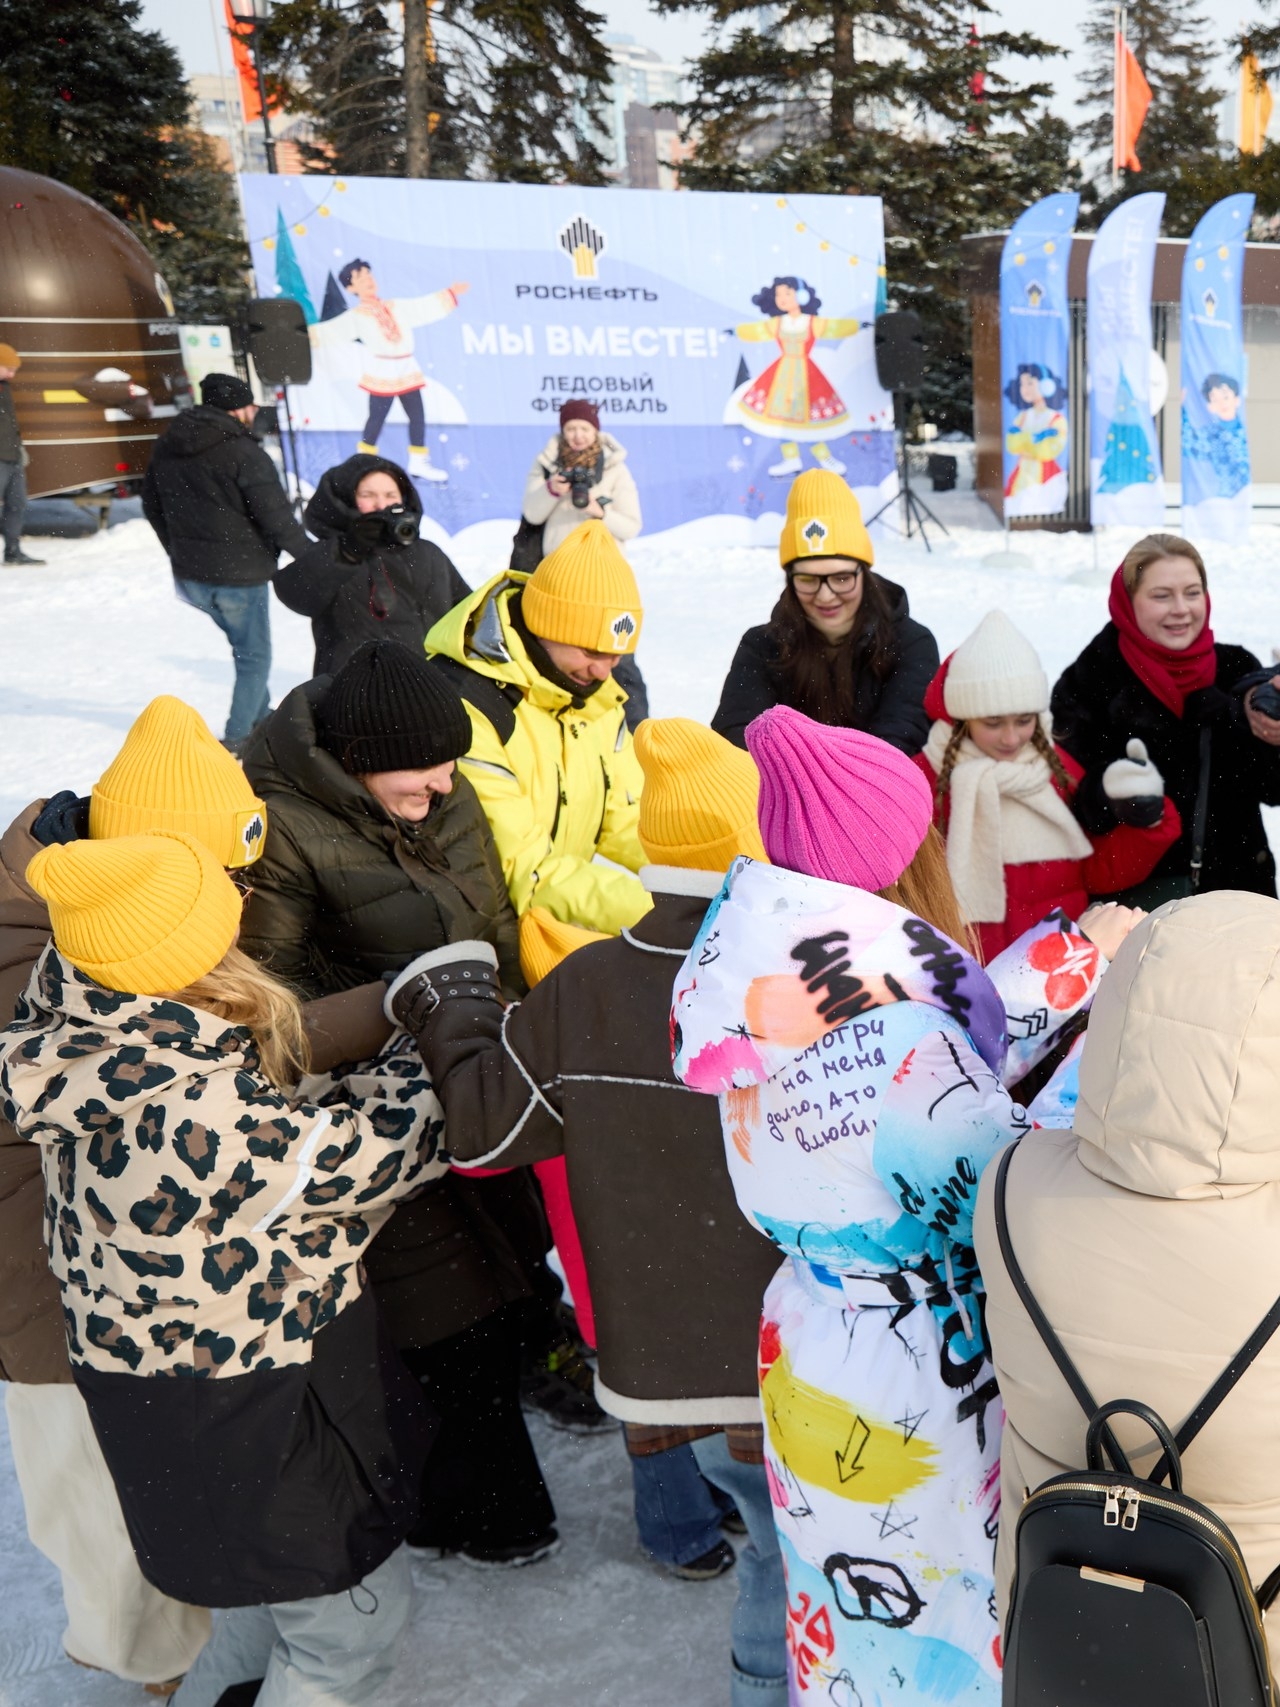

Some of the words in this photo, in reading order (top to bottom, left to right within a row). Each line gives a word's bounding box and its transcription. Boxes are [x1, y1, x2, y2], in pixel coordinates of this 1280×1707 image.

[515, 285, 657, 301] РОСНЕФТЬ
[461, 323, 534, 355] МЫ
[545, 325, 719, 358] ВМЕСТЕ!
[541, 372, 654, 393] ЛЕДОВЫЙ
[531, 398, 668, 413] ФЕИВАЛЬ
[782, 1069, 813, 1093] на
[822, 1047, 886, 1079] меня
[795, 1112, 877, 1152] влюби
